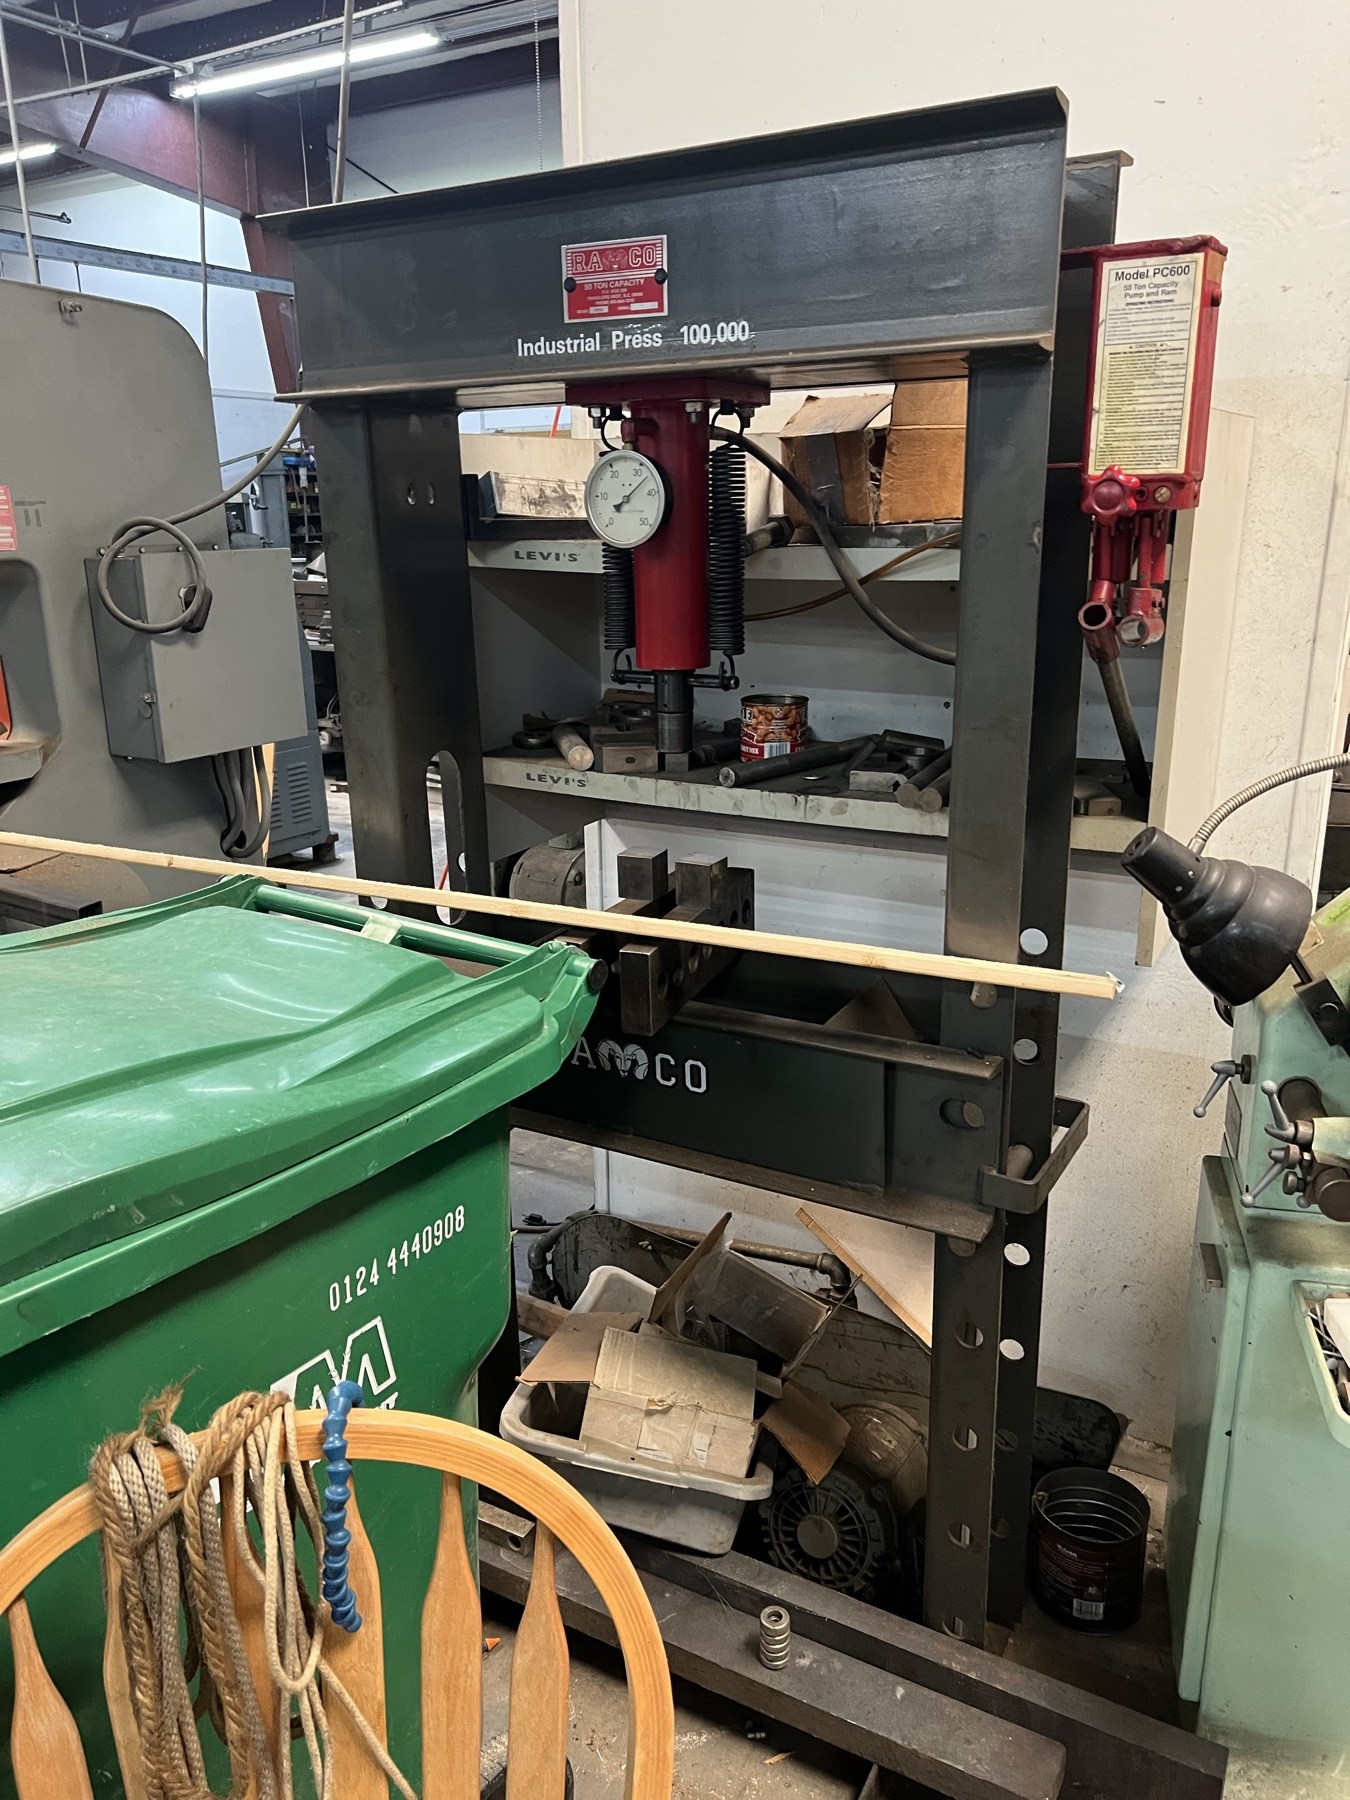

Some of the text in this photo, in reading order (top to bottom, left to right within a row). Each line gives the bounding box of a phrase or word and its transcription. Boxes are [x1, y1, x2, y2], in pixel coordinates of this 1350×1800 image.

[1114, 264, 1191, 282] Model PC600
[593, 281, 609, 289] TON
[609, 278, 646, 289] CAPACITY
[1147, 280, 1179, 291] Capacity
[1123, 288, 1178, 299] Pump and Ram
[517, 320, 750, 357] Industrial Press 100,000
[610, 470, 619, 479] 20
[632, 468, 643, 477] 30
[600, 492, 609, 501] 10
[646, 488, 656, 497] 40
[608, 517, 614, 526] 0
[639, 517, 649, 526] 50
[514, 550, 579, 563] LEVI'S
[525, 772, 587, 788] LEVI'S
[329, 1205, 465, 1311] 0124 4440908
